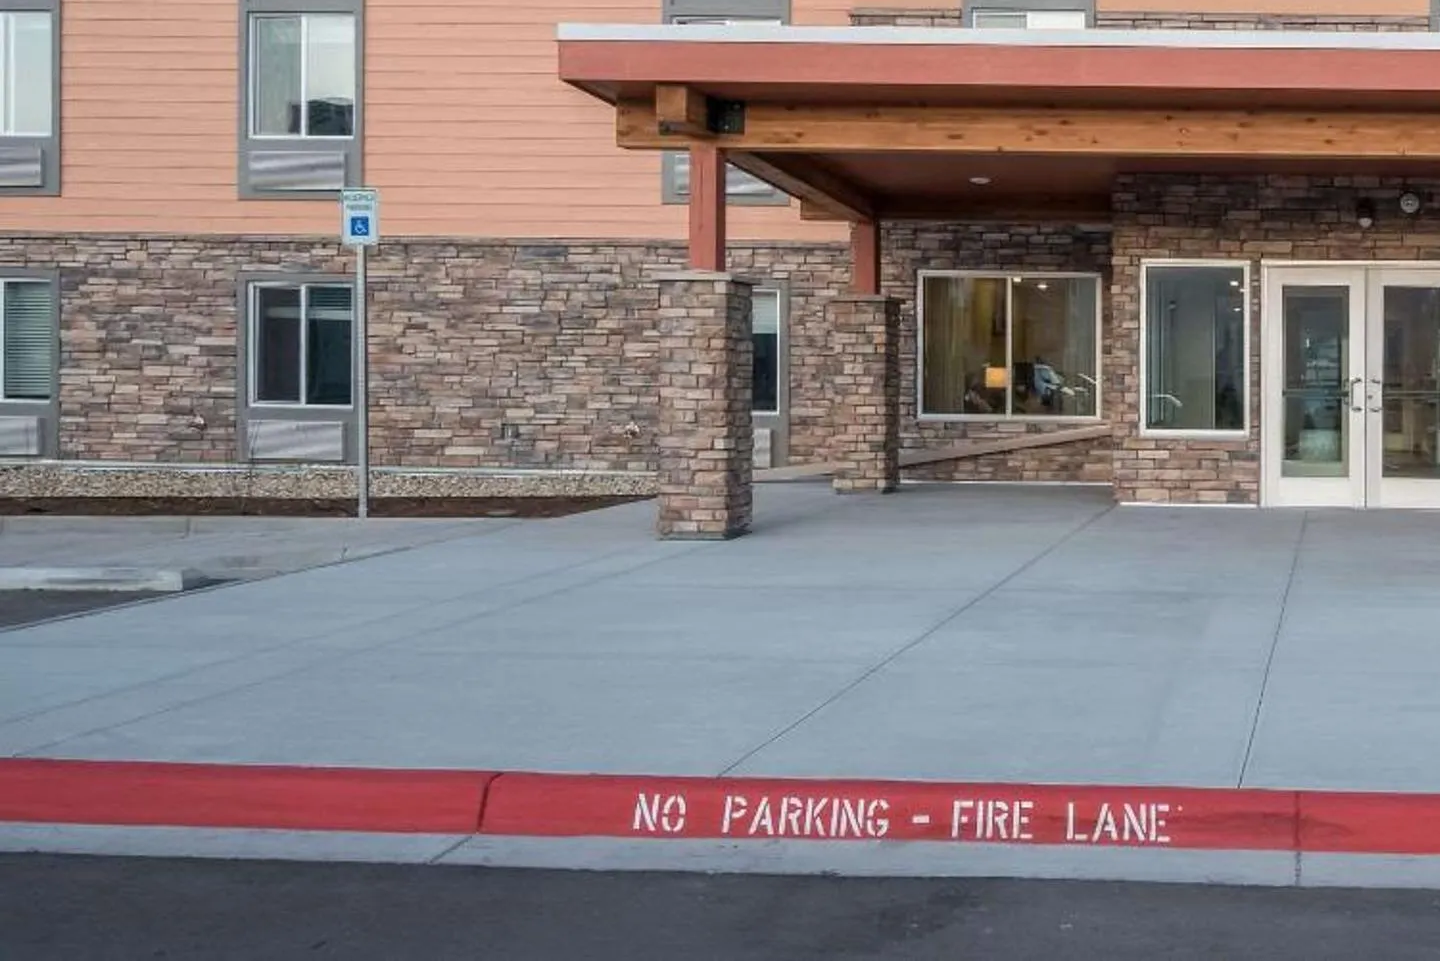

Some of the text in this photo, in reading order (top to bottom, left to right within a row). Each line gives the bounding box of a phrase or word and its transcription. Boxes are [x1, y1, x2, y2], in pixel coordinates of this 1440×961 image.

[632, 793, 687, 833] NO
[721, 795, 890, 837] PARKING
[951, 800, 1034, 839] FIRE
[1066, 802, 1171, 843] LANE
